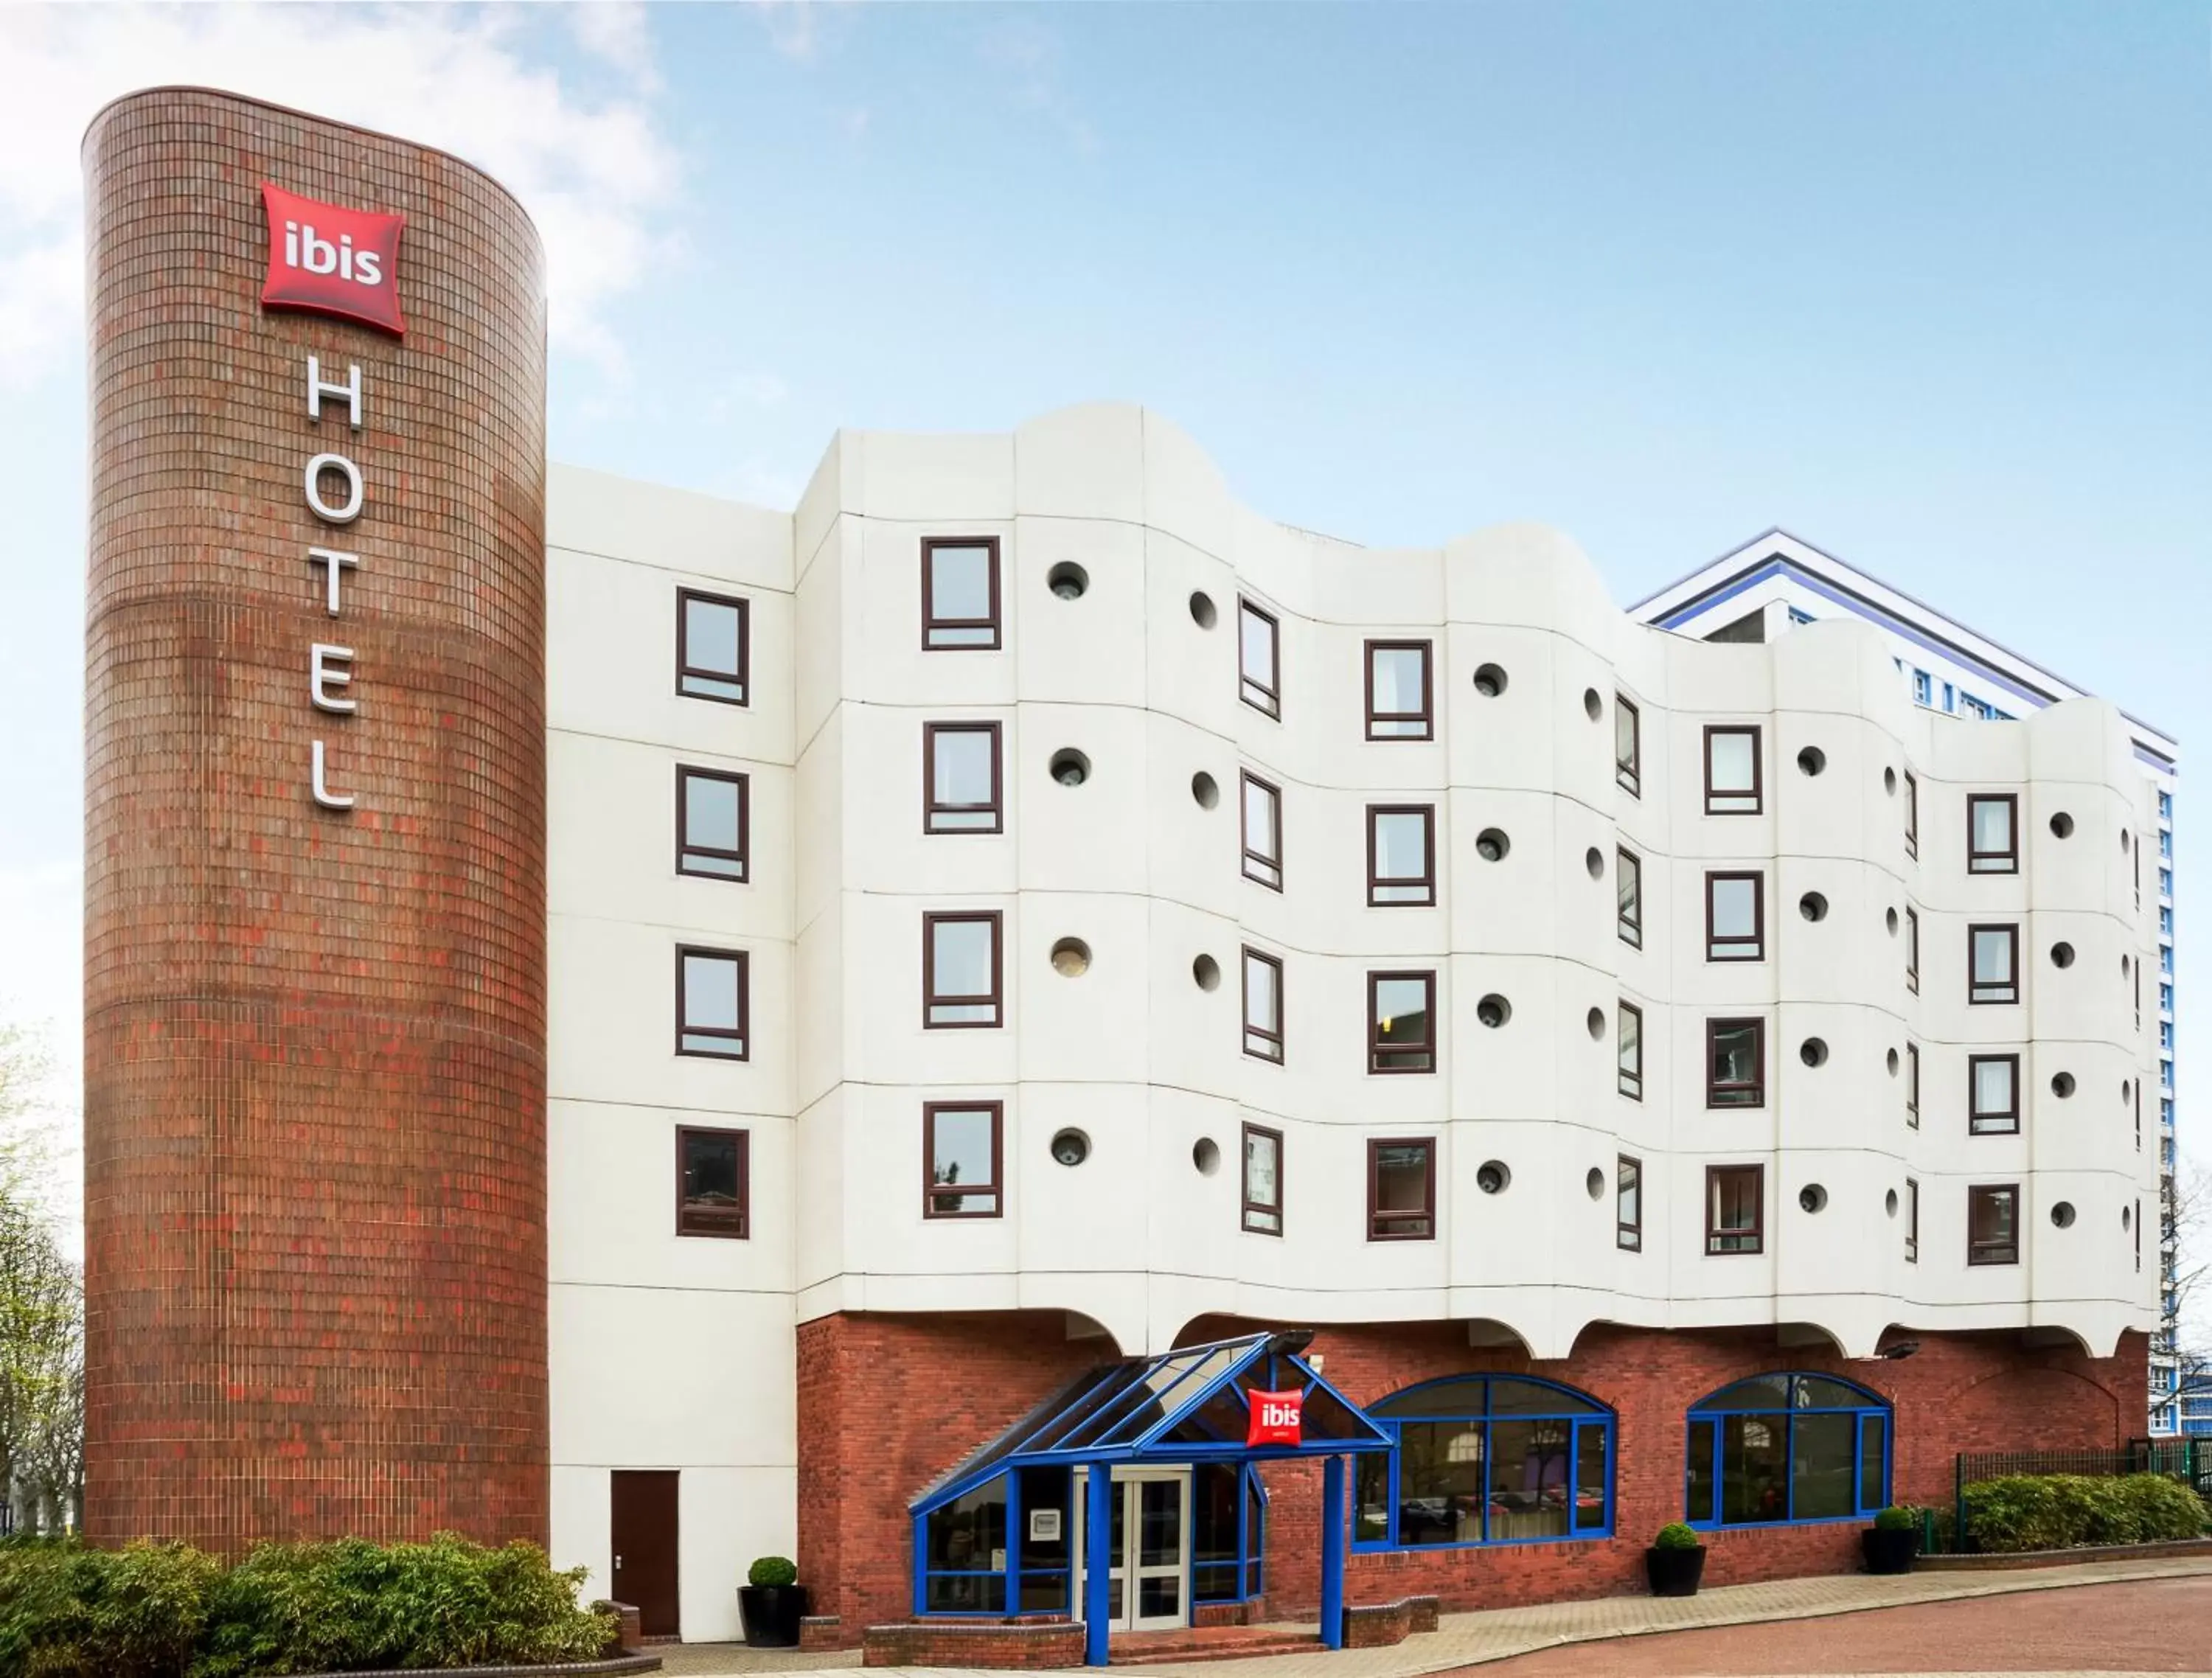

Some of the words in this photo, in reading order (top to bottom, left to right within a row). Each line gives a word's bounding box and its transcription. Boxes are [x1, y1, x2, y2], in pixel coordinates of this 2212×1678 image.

[285, 220, 382, 285] ibis
[305, 355, 364, 810] HOTEL
[1262, 1403, 1300, 1427] ibis
